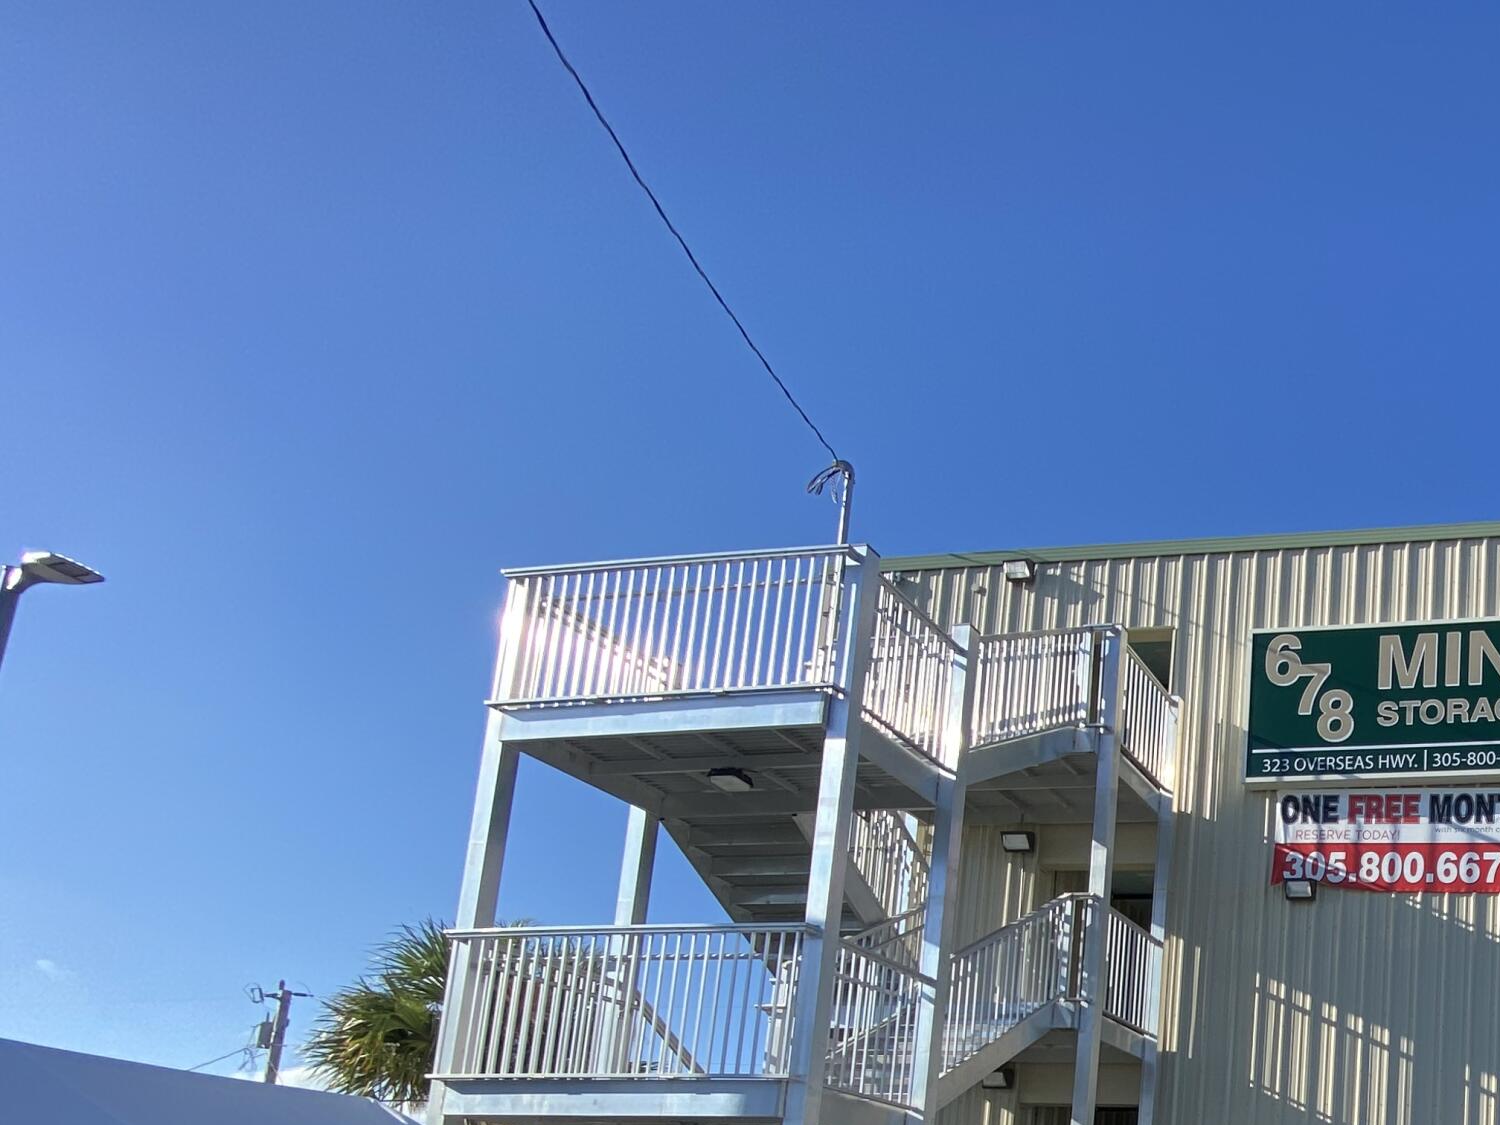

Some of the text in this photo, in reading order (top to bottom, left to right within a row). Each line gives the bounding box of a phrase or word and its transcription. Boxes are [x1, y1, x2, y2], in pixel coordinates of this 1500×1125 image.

[1265, 633, 1355, 743] 678
[1262, 757, 1290, 773] 323
[1294, 754, 1374, 772] OVERSEAS
[1378, 752, 1419, 770] HWY.
[1281, 794, 1340, 825] ONE
[1347, 793, 1421, 825] FREE
[1295, 828, 1401, 841] RESERVE TODAY!
